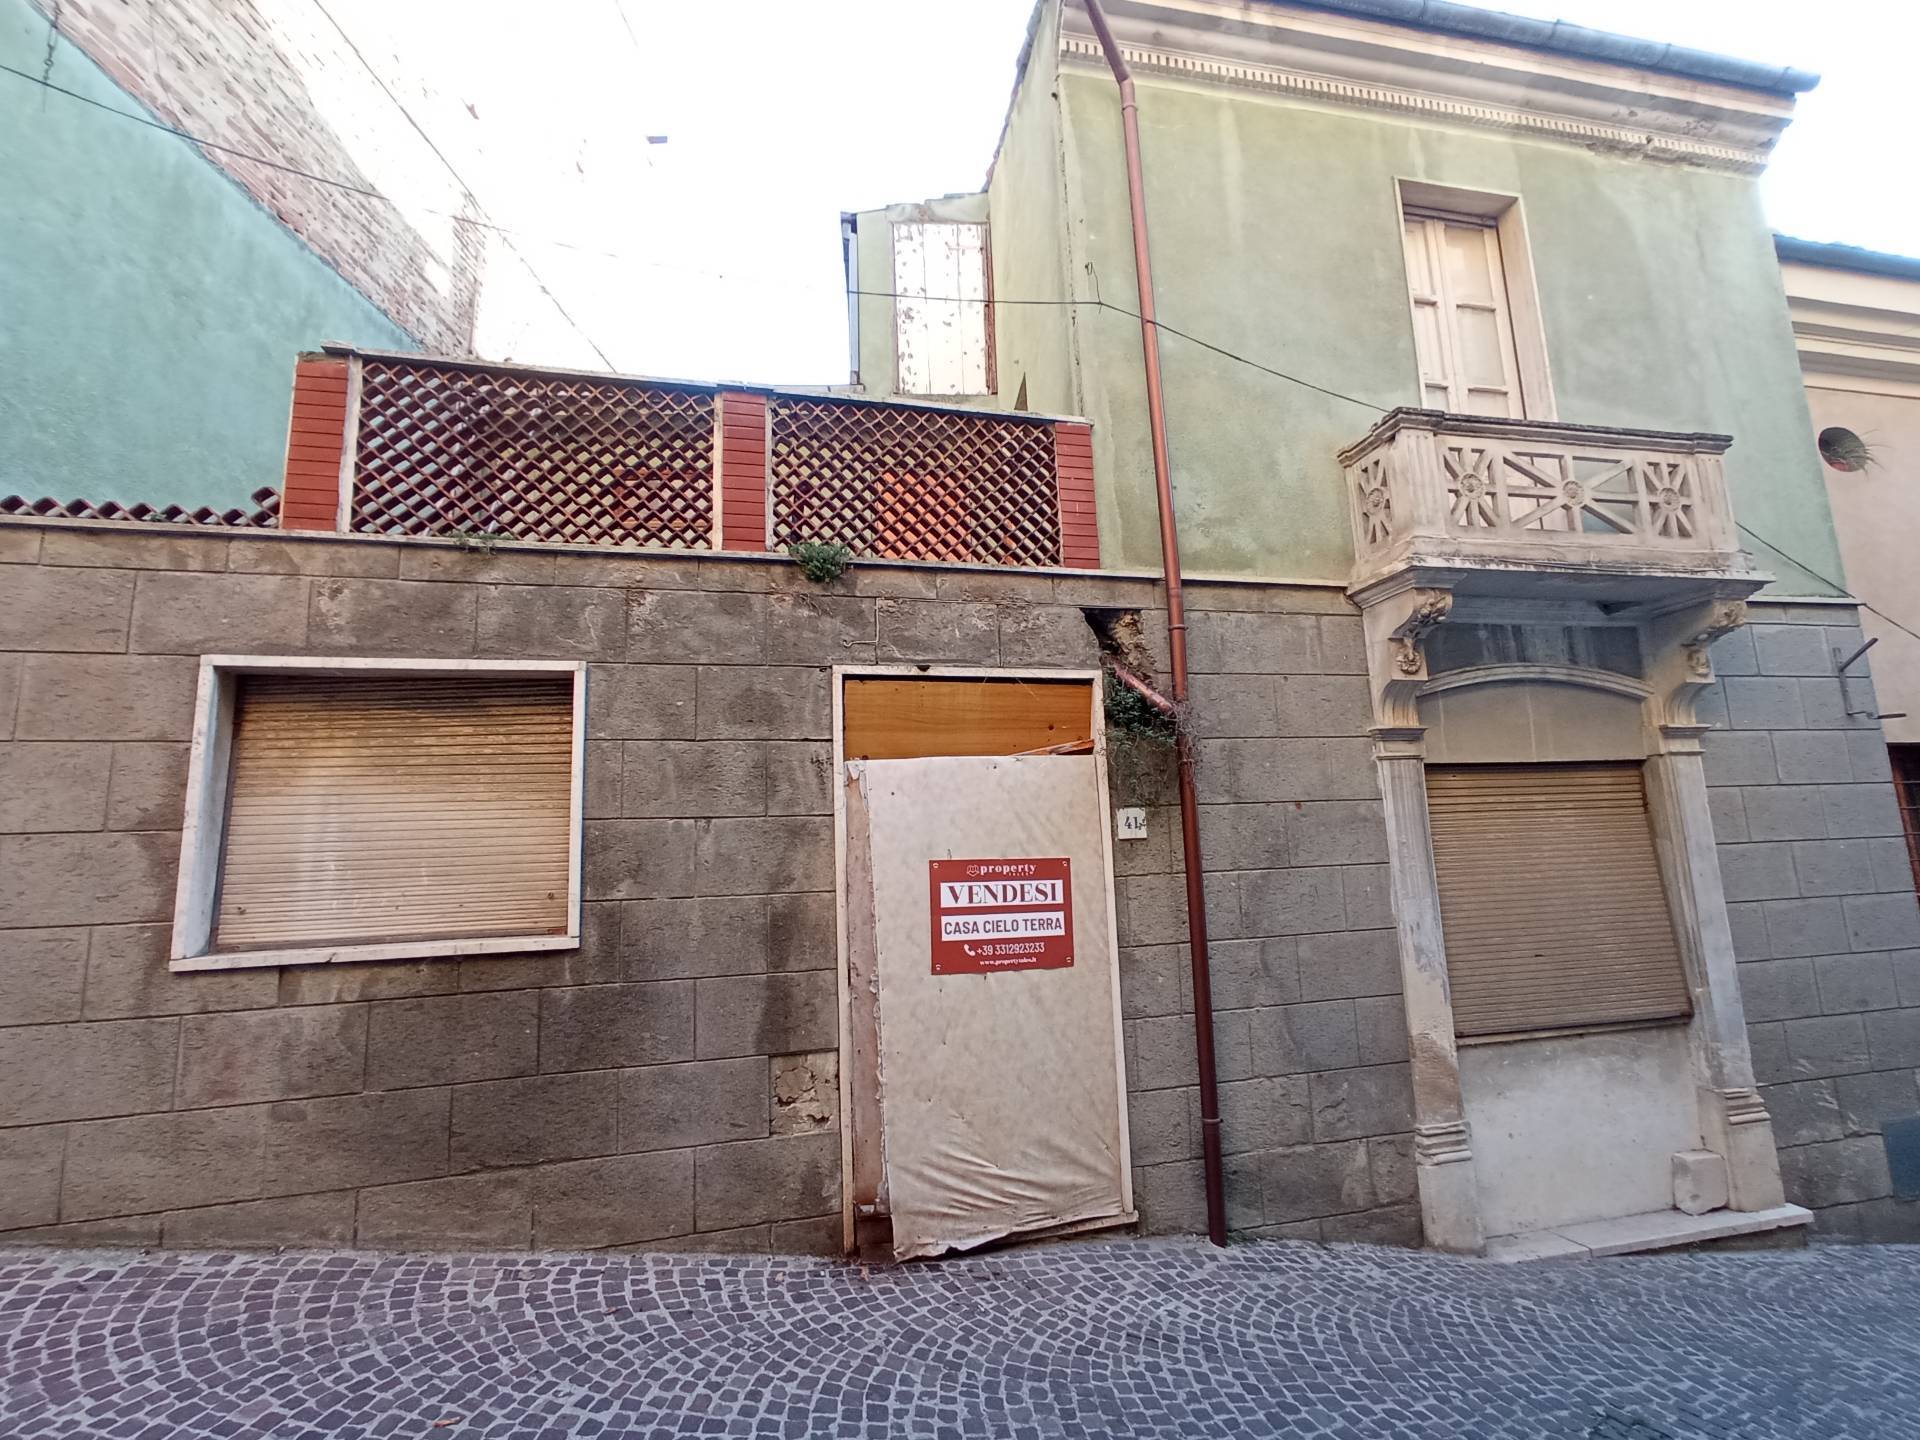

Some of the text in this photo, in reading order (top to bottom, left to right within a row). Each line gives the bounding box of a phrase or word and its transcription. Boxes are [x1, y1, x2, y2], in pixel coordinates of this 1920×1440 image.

[980, 864, 1036, 875] property
[947, 883, 1057, 904] VENDESI
[944, 917, 1062, 935] CASA CIELO TERRA
[976, 942, 1045, 956] +39 3312923233
